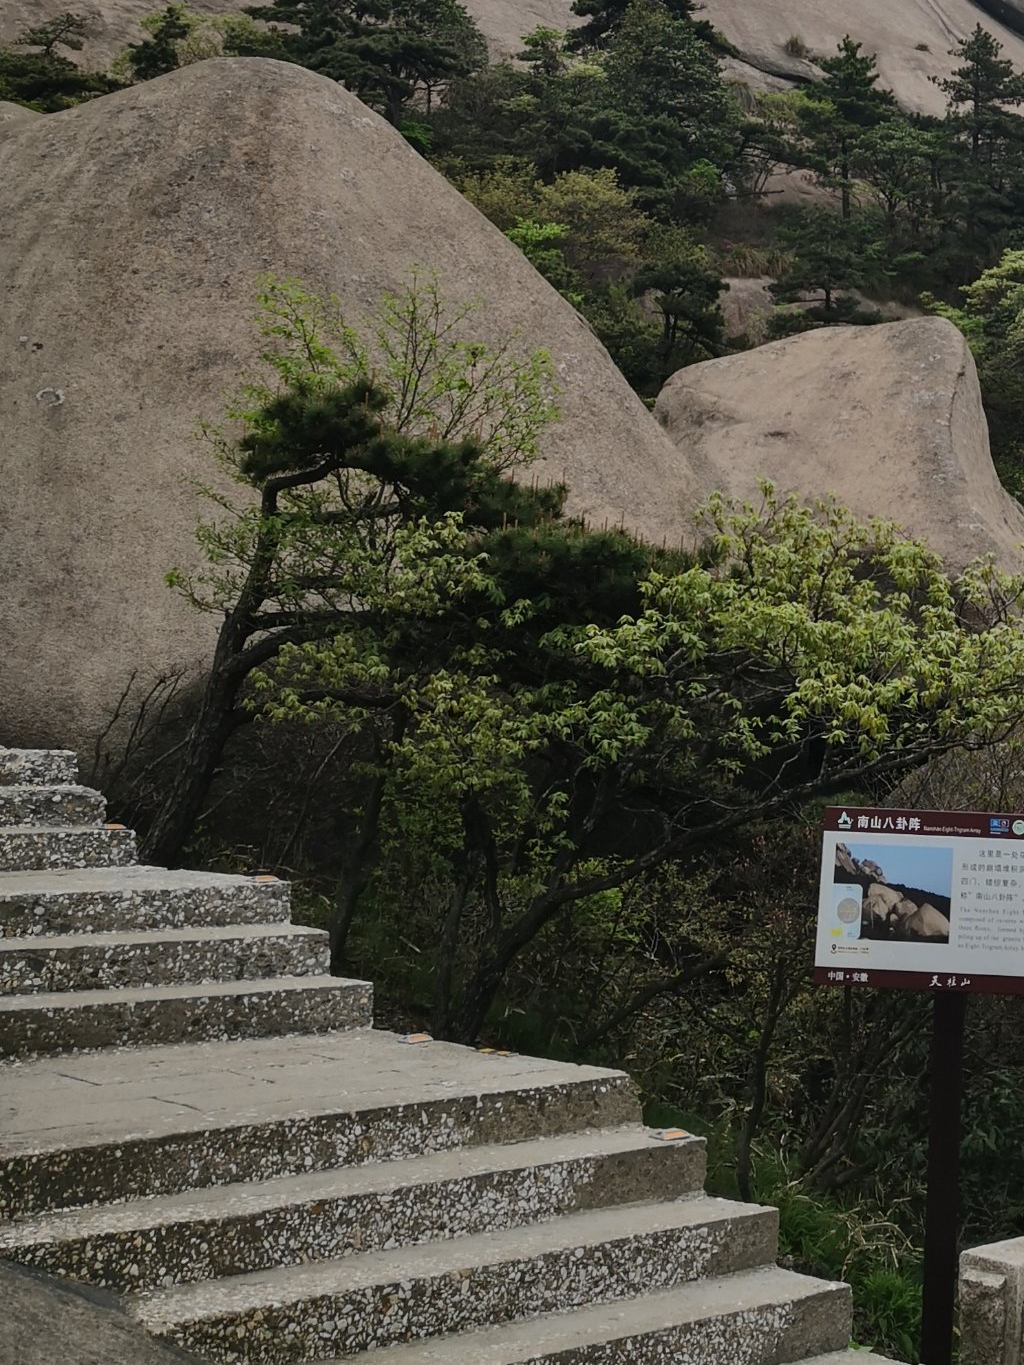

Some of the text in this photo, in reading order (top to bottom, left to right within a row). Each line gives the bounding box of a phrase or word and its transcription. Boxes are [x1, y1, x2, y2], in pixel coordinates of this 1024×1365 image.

[857, 815, 921, 831] 南山八卦阵
[959, 906, 970, 914] The
[929, 974, 971, 987] 天柱山
